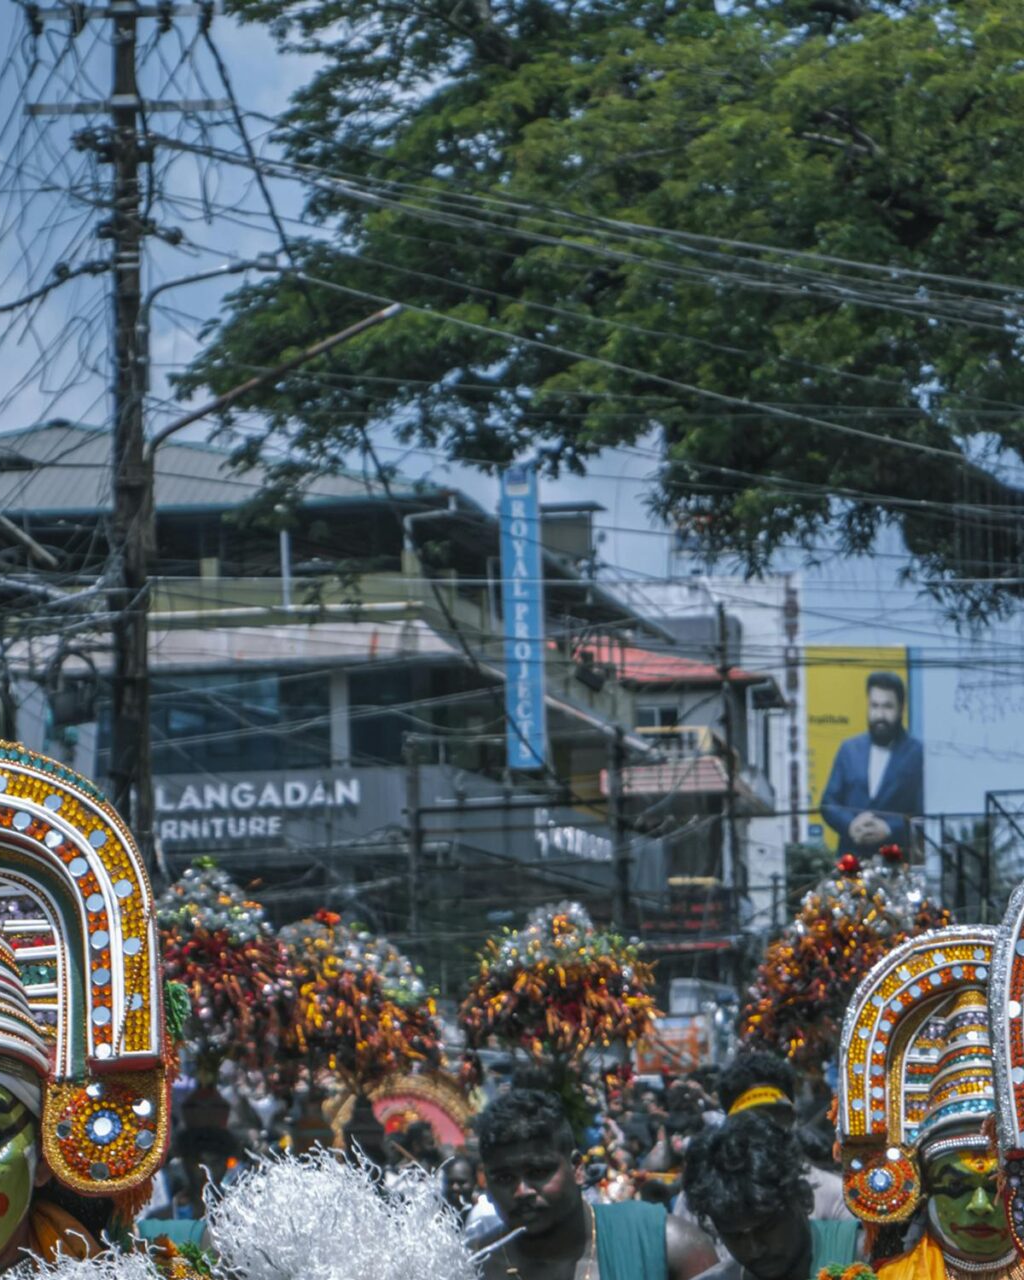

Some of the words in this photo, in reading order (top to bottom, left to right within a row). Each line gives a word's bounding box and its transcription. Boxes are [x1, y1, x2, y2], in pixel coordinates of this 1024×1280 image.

[510, 500, 528, 597] ROYAL
[512, 601, 533, 759] PROJECTS
[154, 778, 360, 812] LANGADAN
[153, 816, 282, 840] RNITURE
